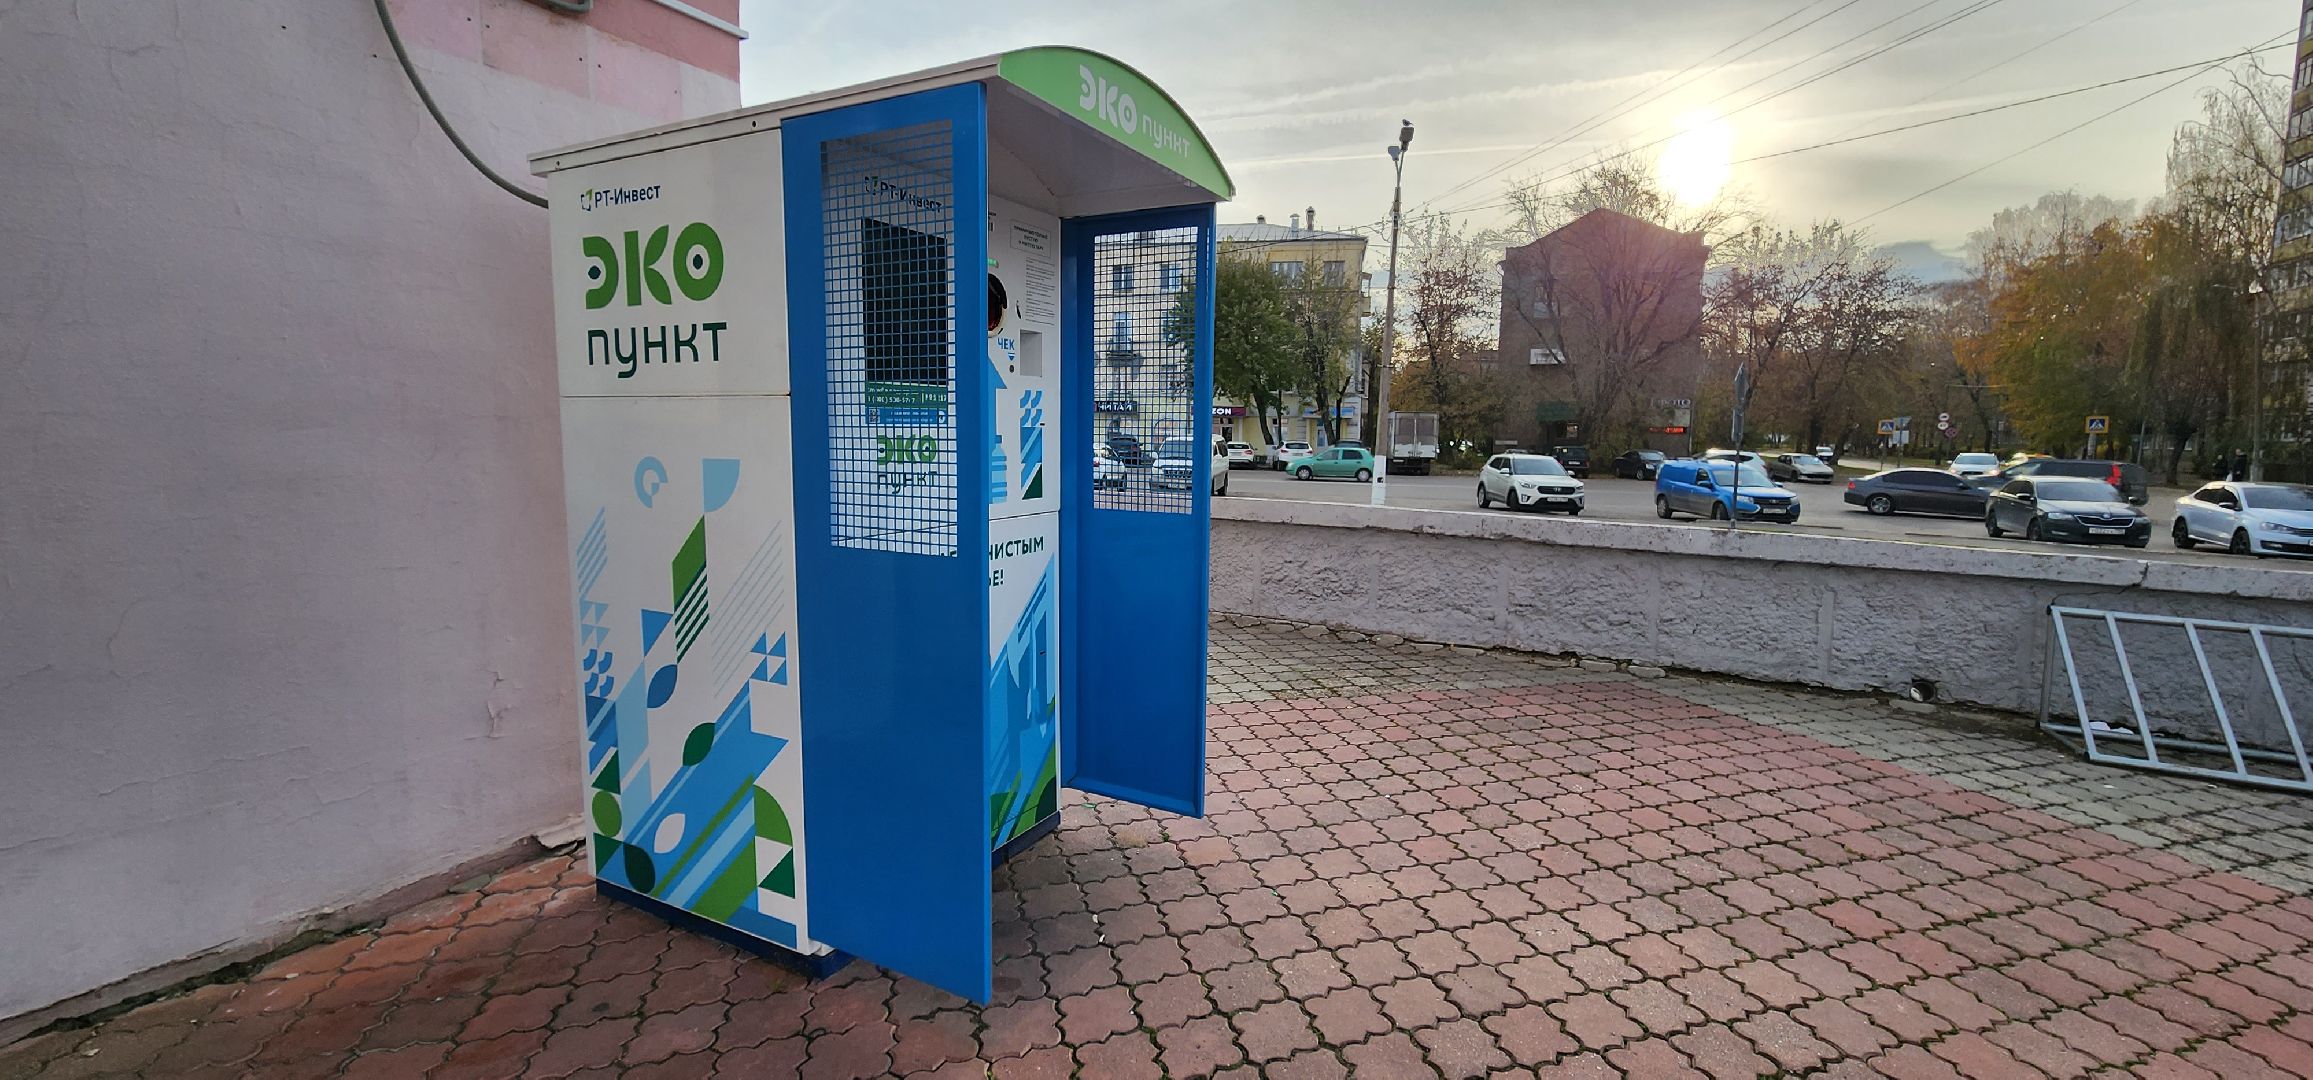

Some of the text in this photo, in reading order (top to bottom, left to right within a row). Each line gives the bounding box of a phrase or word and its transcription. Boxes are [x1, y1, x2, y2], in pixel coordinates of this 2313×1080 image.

[1079, 64, 1191, 158] ЭКО пункт
[595, 185, 661, 208] РТ-Инвест
[582, 222, 724, 310] ЭКО
[587, 321, 728, 379] пункт
[998, 338, 1015, 350] ЧЕК
[877, 434, 937, 465] ЭКО
